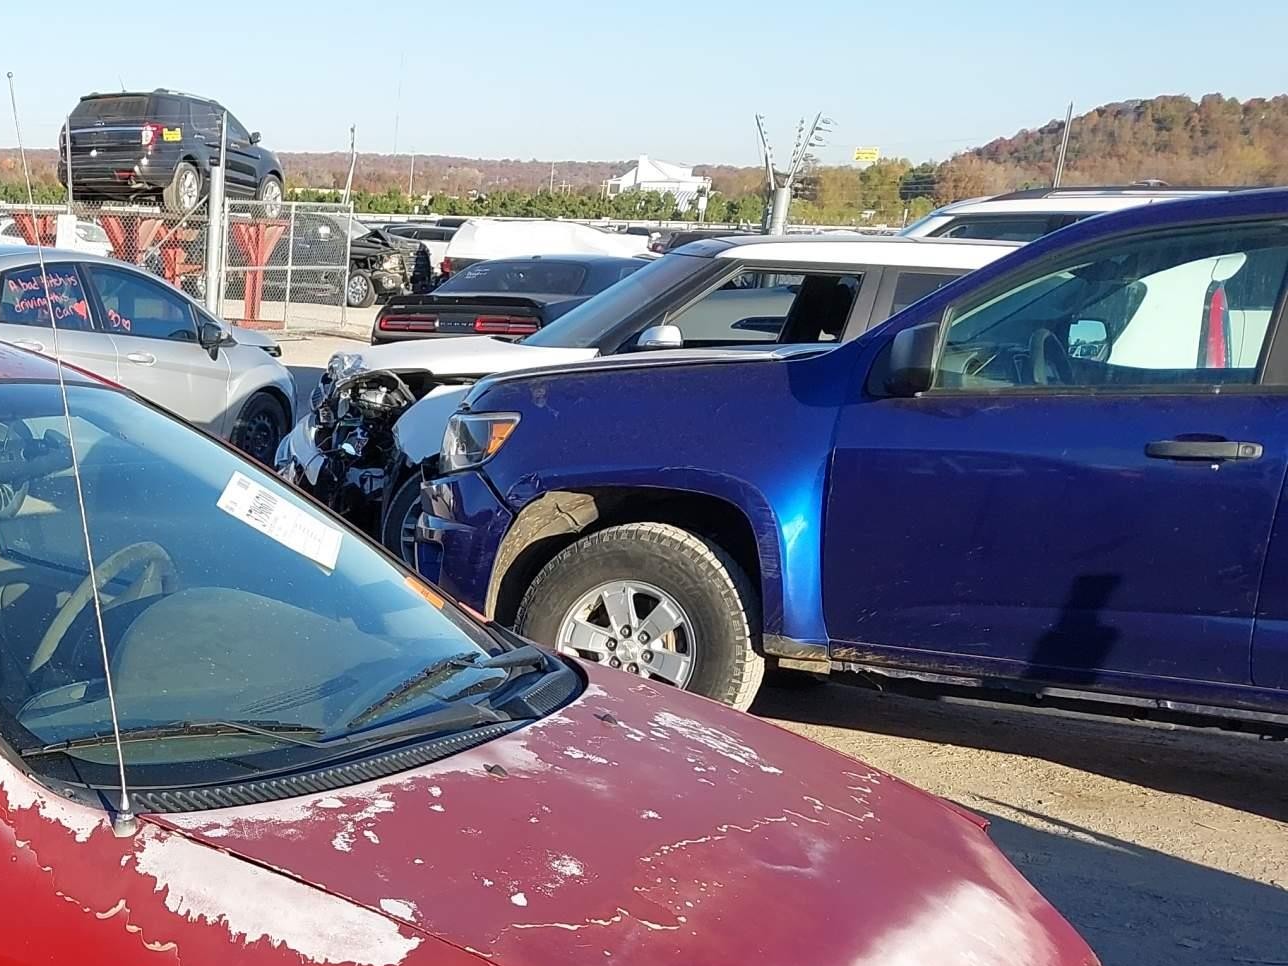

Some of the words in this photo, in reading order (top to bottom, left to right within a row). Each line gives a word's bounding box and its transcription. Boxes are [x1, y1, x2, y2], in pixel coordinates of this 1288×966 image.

[17, 277, 40, 291] bad
[65, 274, 78, 287] is
[14, 296, 50, 313] driving
[49, 291, 70, 304] this
